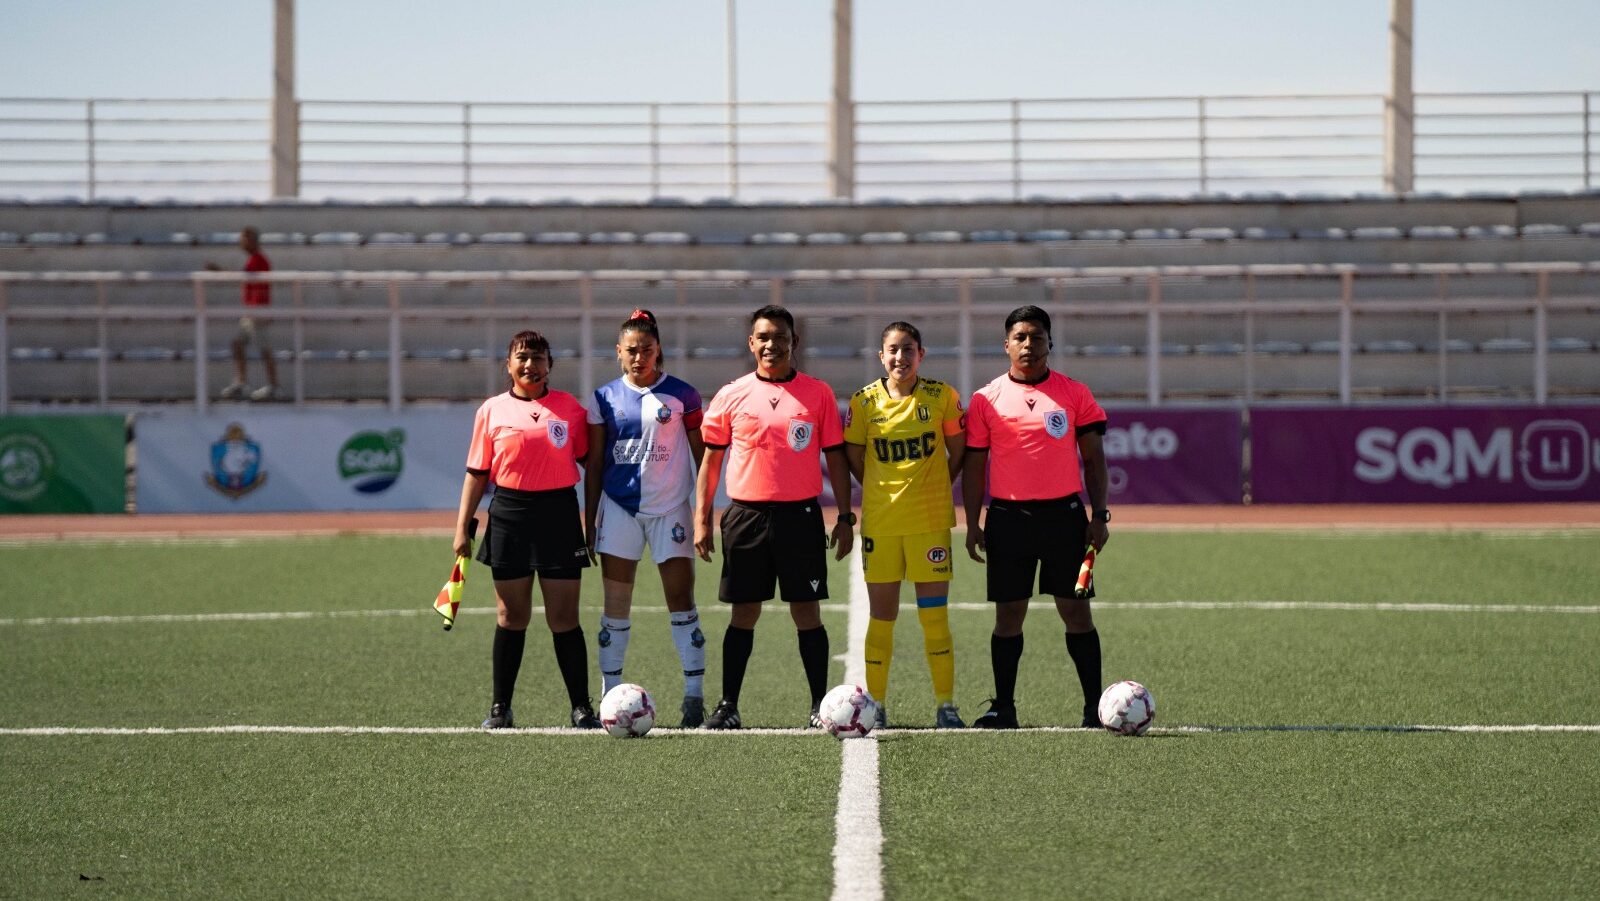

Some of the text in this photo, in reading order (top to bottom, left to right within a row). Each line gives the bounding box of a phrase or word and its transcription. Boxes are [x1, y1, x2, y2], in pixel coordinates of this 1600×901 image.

[873, 431, 936, 463] UDEC
[1103, 422, 1178, 459] ato
[343, 448, 398, 469] SQM
[1353, 427, 1513, 488] SQM
[932, 549, 944, 560] PF
